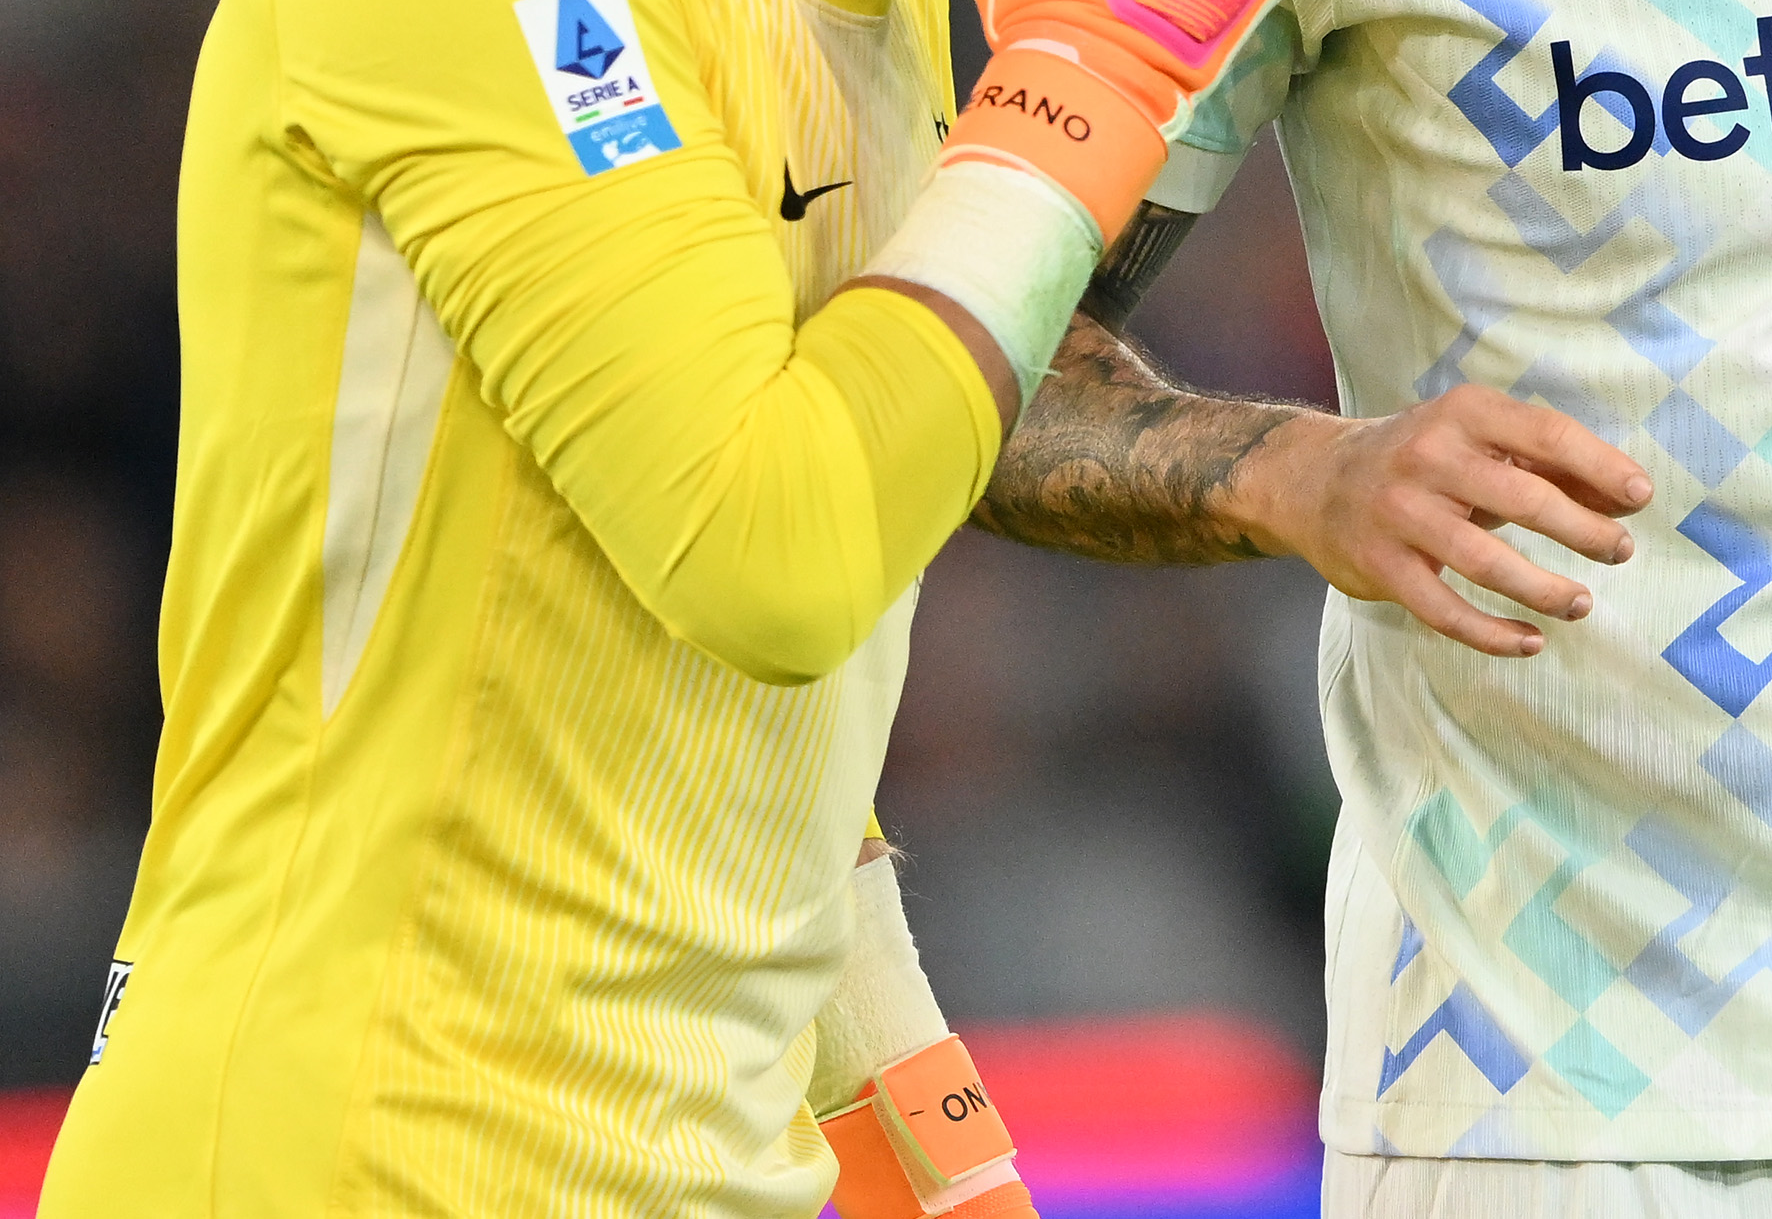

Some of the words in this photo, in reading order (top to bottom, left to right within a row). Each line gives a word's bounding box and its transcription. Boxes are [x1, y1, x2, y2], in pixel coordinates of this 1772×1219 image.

[567, 80, 624, 112] SERIE
[627, 76, 641, 92] A
[964, 85, 1091, 142] RANO
[941, 1081, 992, 1122] ON
